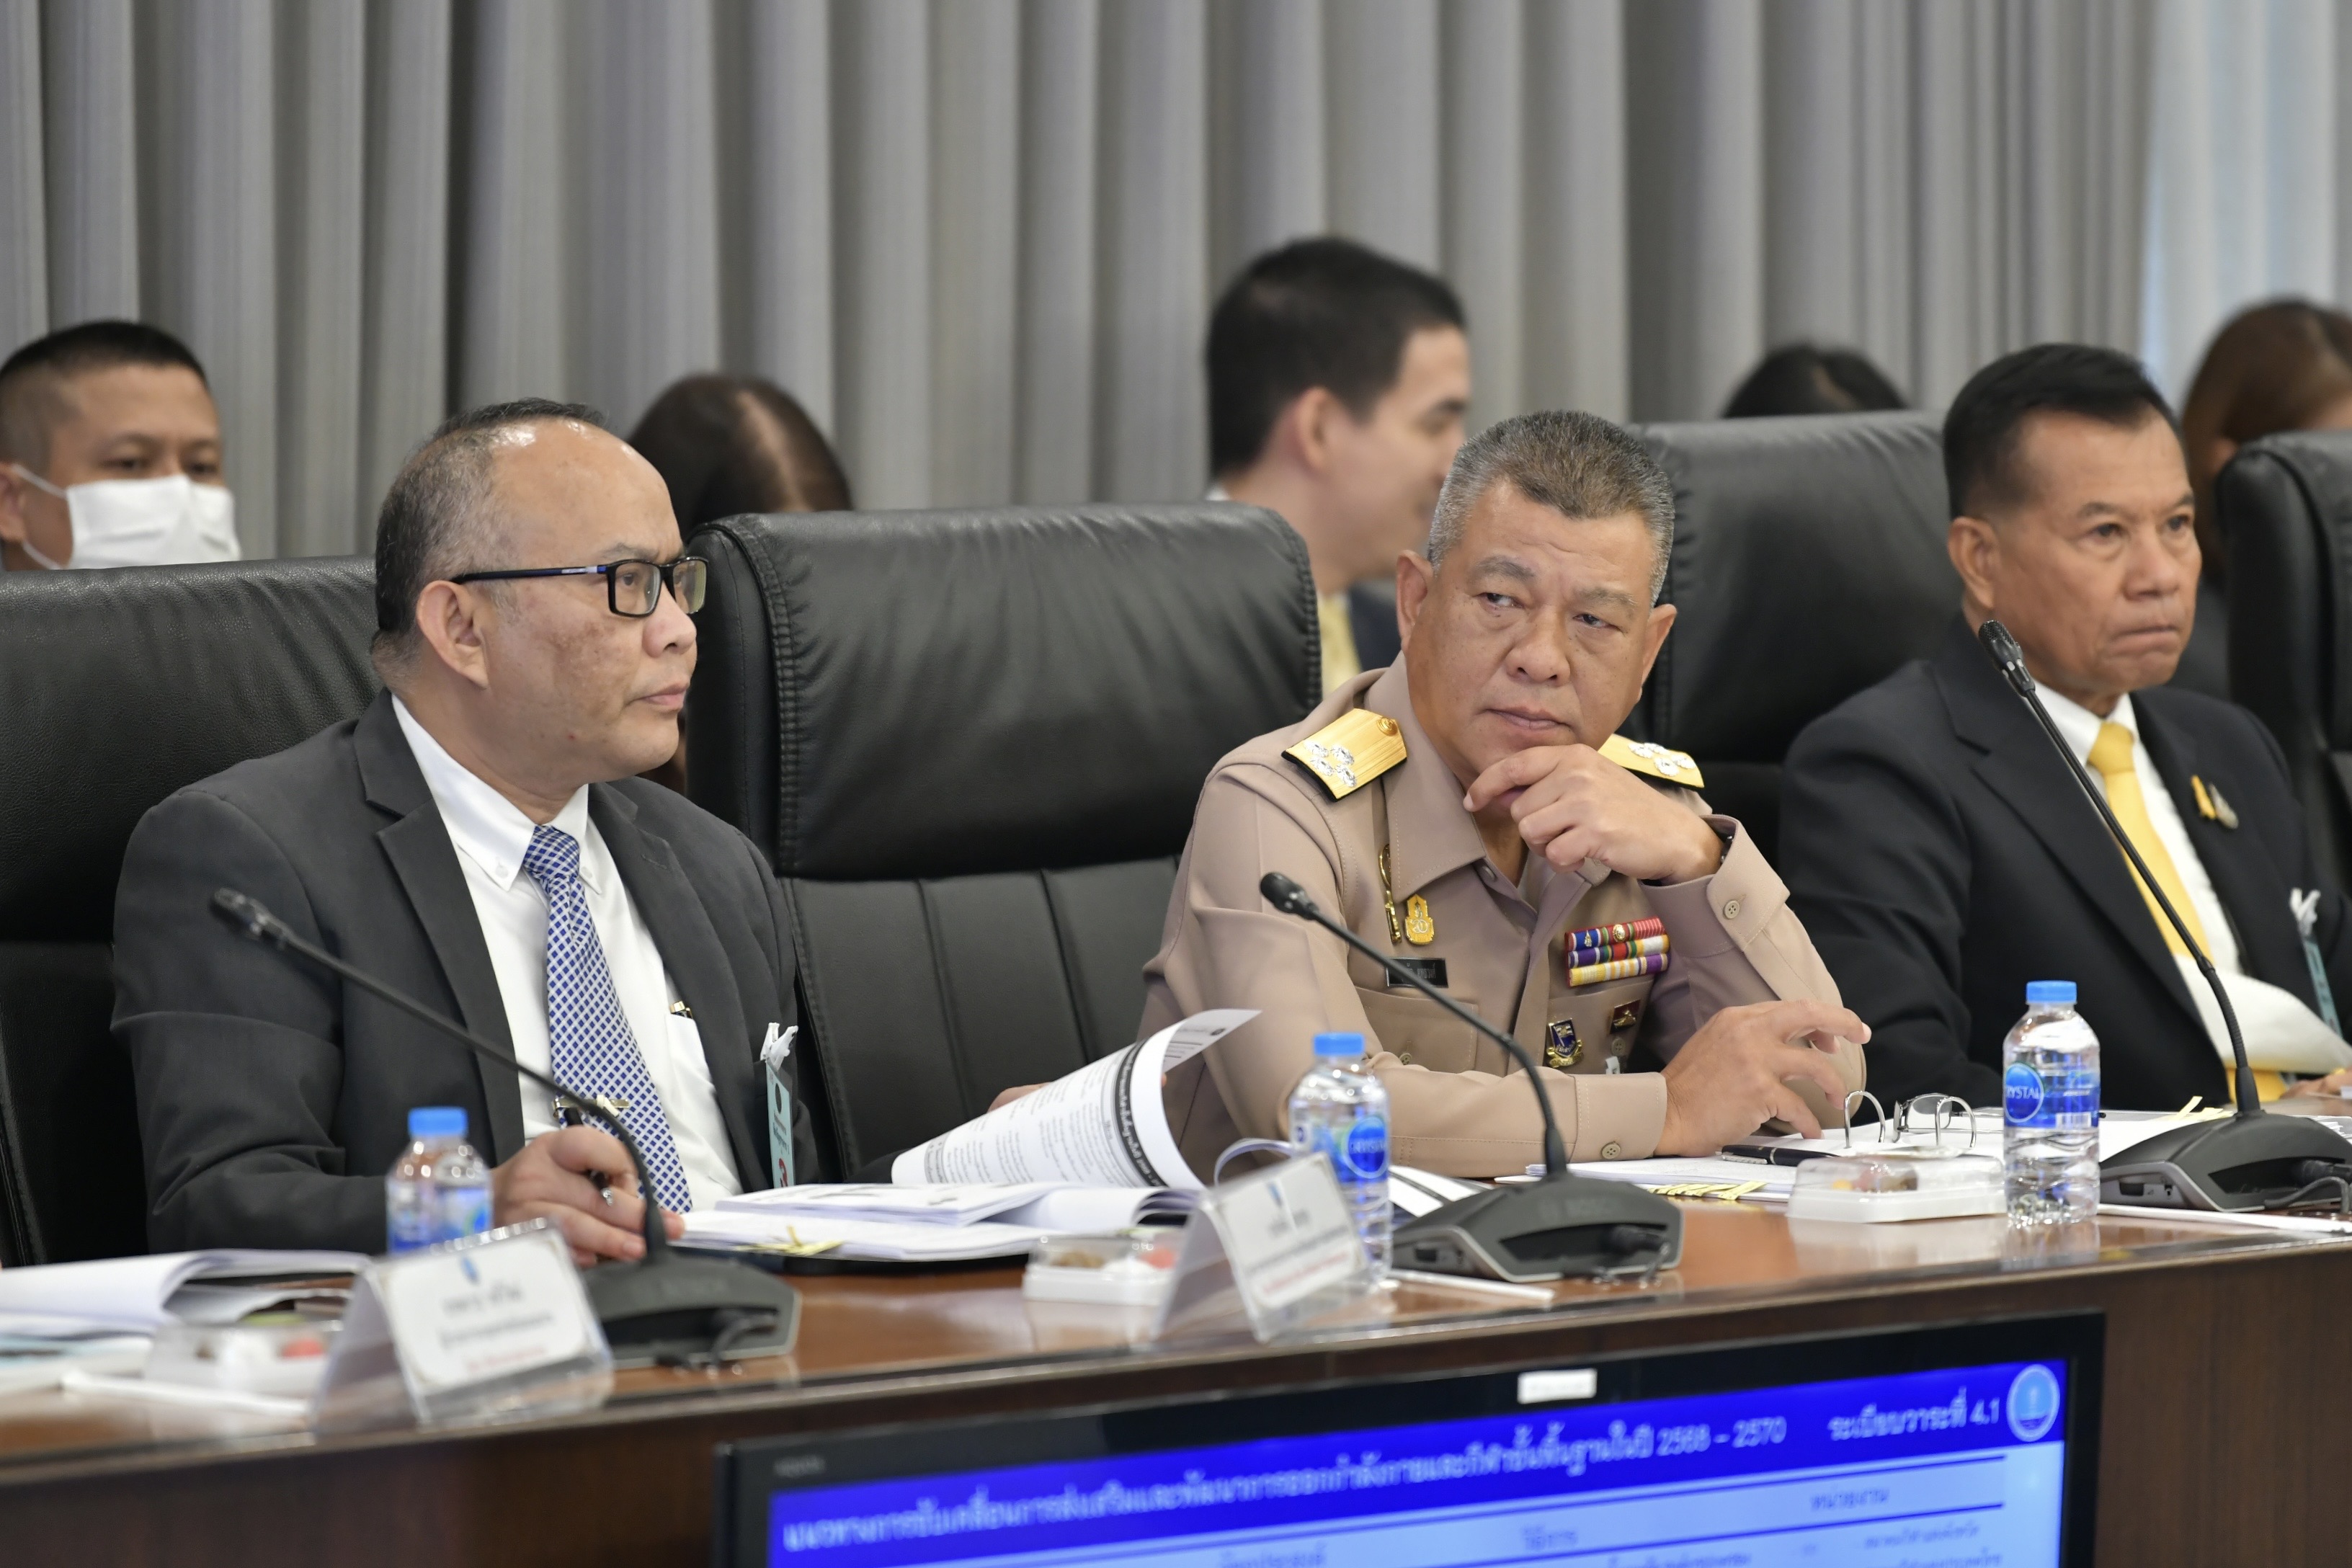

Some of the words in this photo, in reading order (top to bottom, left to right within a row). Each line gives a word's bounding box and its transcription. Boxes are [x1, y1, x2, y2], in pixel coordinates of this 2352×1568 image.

[2006, 1084, 2041, 1100] RYSTAL
[1827, 1386, 1968, 1442] ระเบียบวาระที่
[1969, 1396, 2000, 1426] 4.1
[1732, 1415, 1788, 1449] 2570
